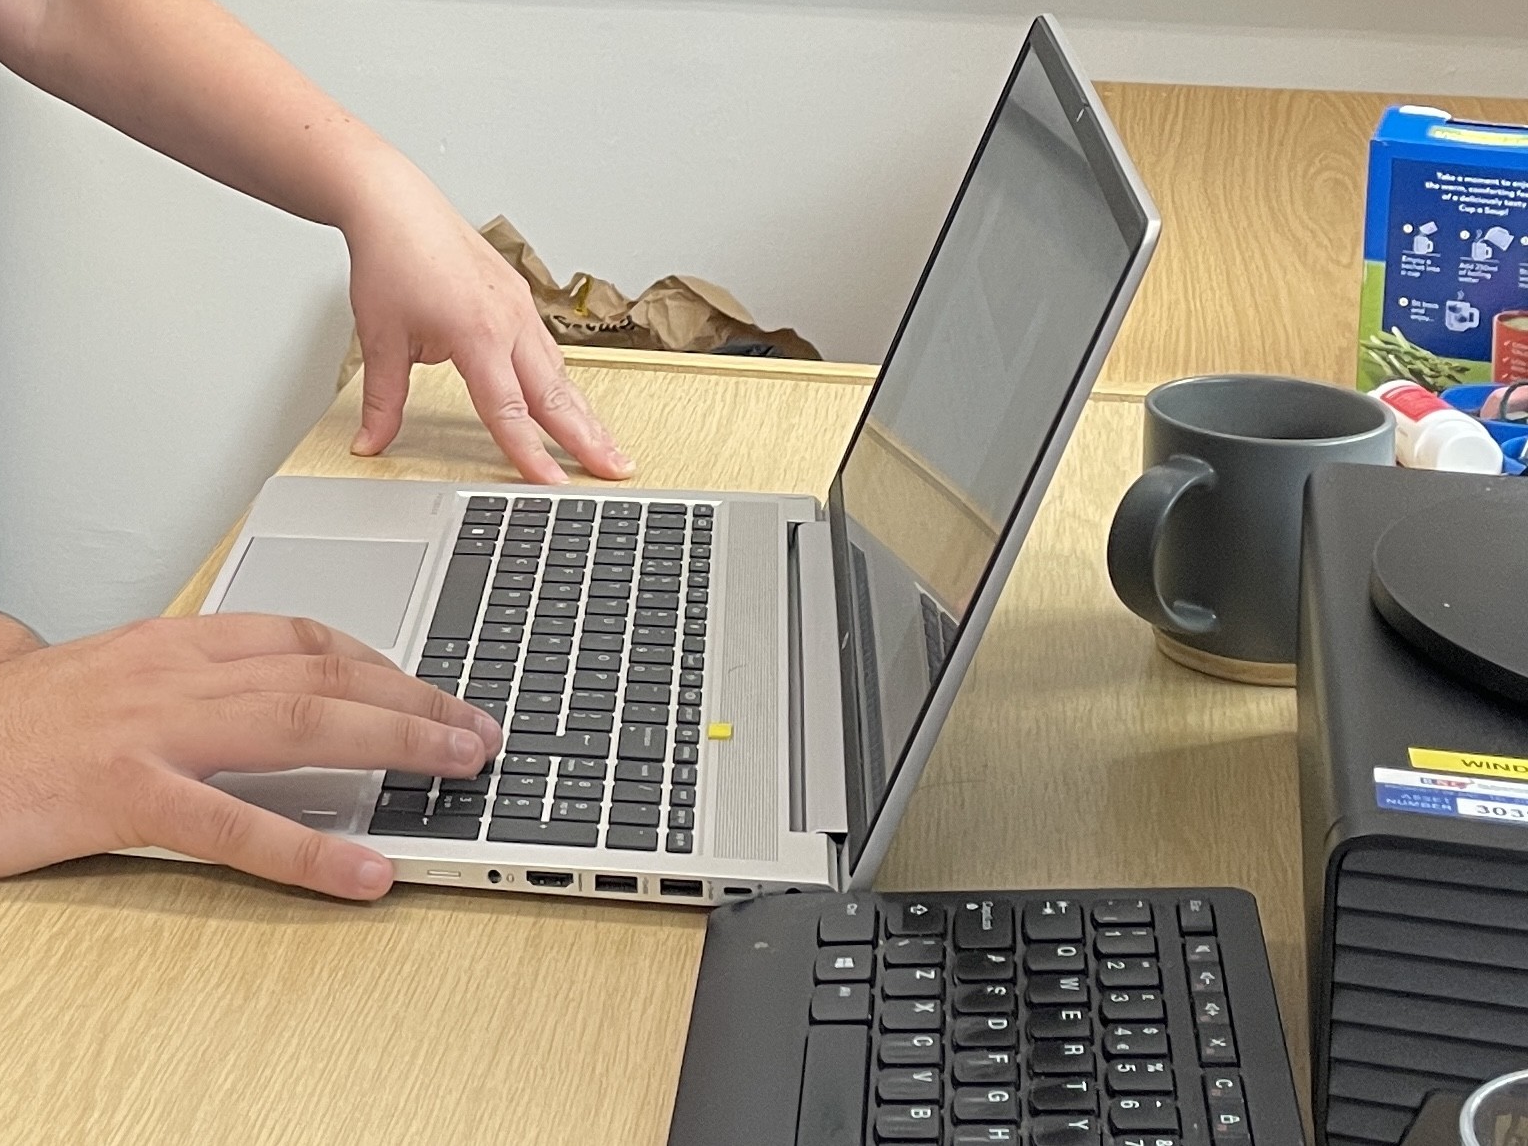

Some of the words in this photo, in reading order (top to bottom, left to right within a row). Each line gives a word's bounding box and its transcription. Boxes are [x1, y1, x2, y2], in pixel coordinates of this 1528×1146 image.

[1436, 171, 1456, 181] Take
[1464, 177, 1500, 185] moment
[1425, 181, 1440, 190] the
[1468, 187, 1515, 198] comforting
[1460, 195, 1502, 206] deliciously
[1504, 199, 1527, 208] tasty
[1459, 203, 1476, 214] Cup
[1461, 759, 1528, 773] WIND
[1401, 793, 1450, 804] ASSET
[1386, 798, 1452, 811] NUMBER
[1476, 804, 1528, 818] 303
[1057, 947, 1077, 956] Q
[1107, 961, 1125, 970] 2
[916, 969, 935, 979] Z
[1060, 977, 1079, 990] W
[1110, 993, 1129, 1002] 3
[913, 1003, 935, 1013] X
[1061, 1010, 1082, 1020] E
[988, 1019, 1008, 1029] D
[1114, 1027, 1132, 1036] 4
[913, 1036, 933, 1046] C
[1063, 1044, 1084, 1055] R
[988, 1054, 1008, 1063] F
[1117, 1063, 1137, 1073] 5
[912, 1071, 933, 1082] V
[1066, 1080, 1087, 1092] T
[988, 1091, 1009, 1102] G
[1120, 1099, 1140, 1109] 6
[910, 1107, 932, 1118] B
[1068, 1119, 1089, 1130] Y
[989, 1128, 1009, 1140] H
